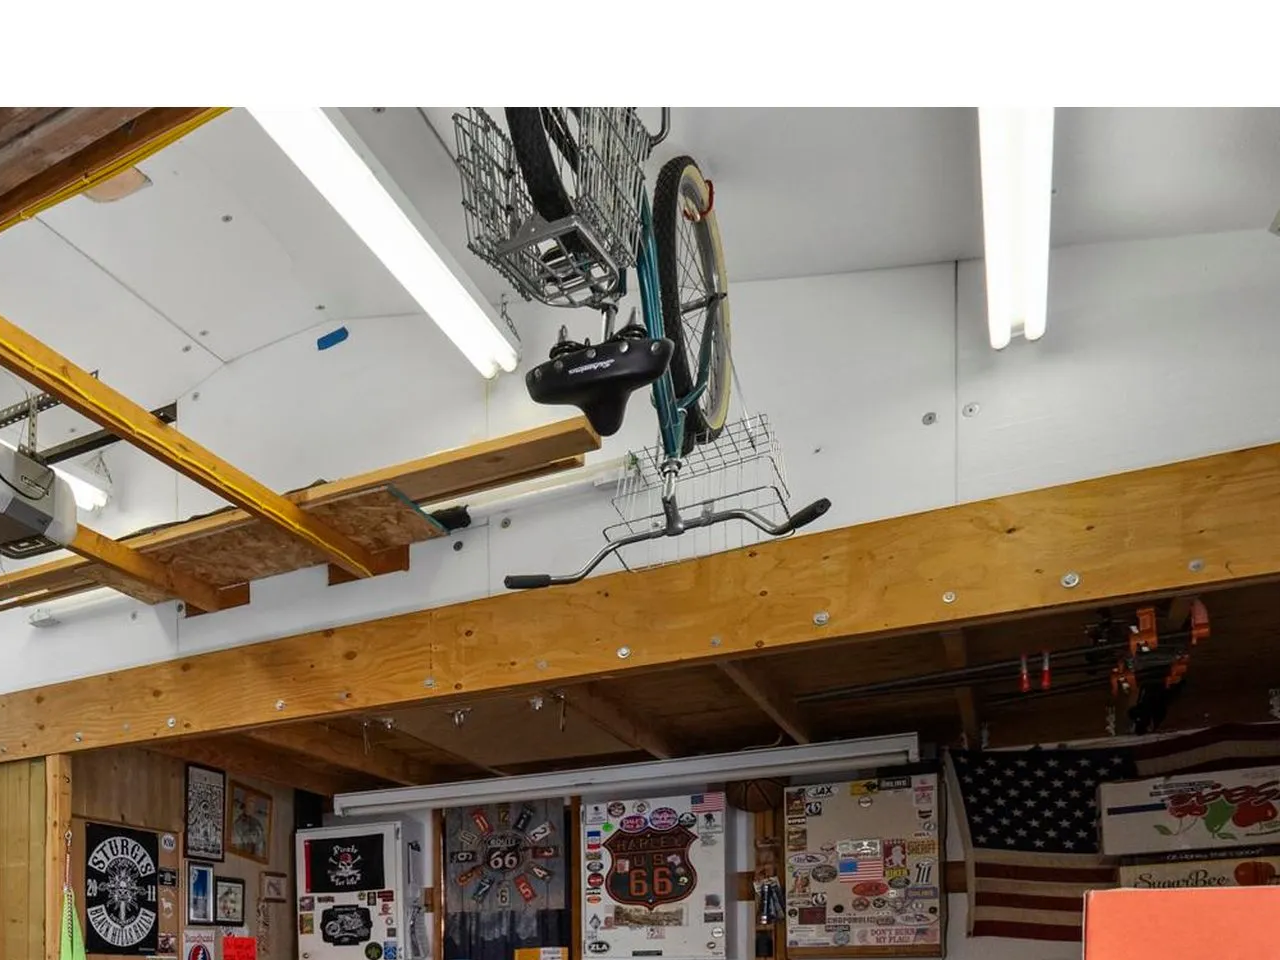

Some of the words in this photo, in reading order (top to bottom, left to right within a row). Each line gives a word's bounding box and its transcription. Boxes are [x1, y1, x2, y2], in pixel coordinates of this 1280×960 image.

[619, 835, 682, 851] HARLEY
[90, 837, 154, 876] STURGIS
[490, 851, 517, 869] 66
[630, 867, 673, 897] 66
[590, 942, 609, 951] ZLA
